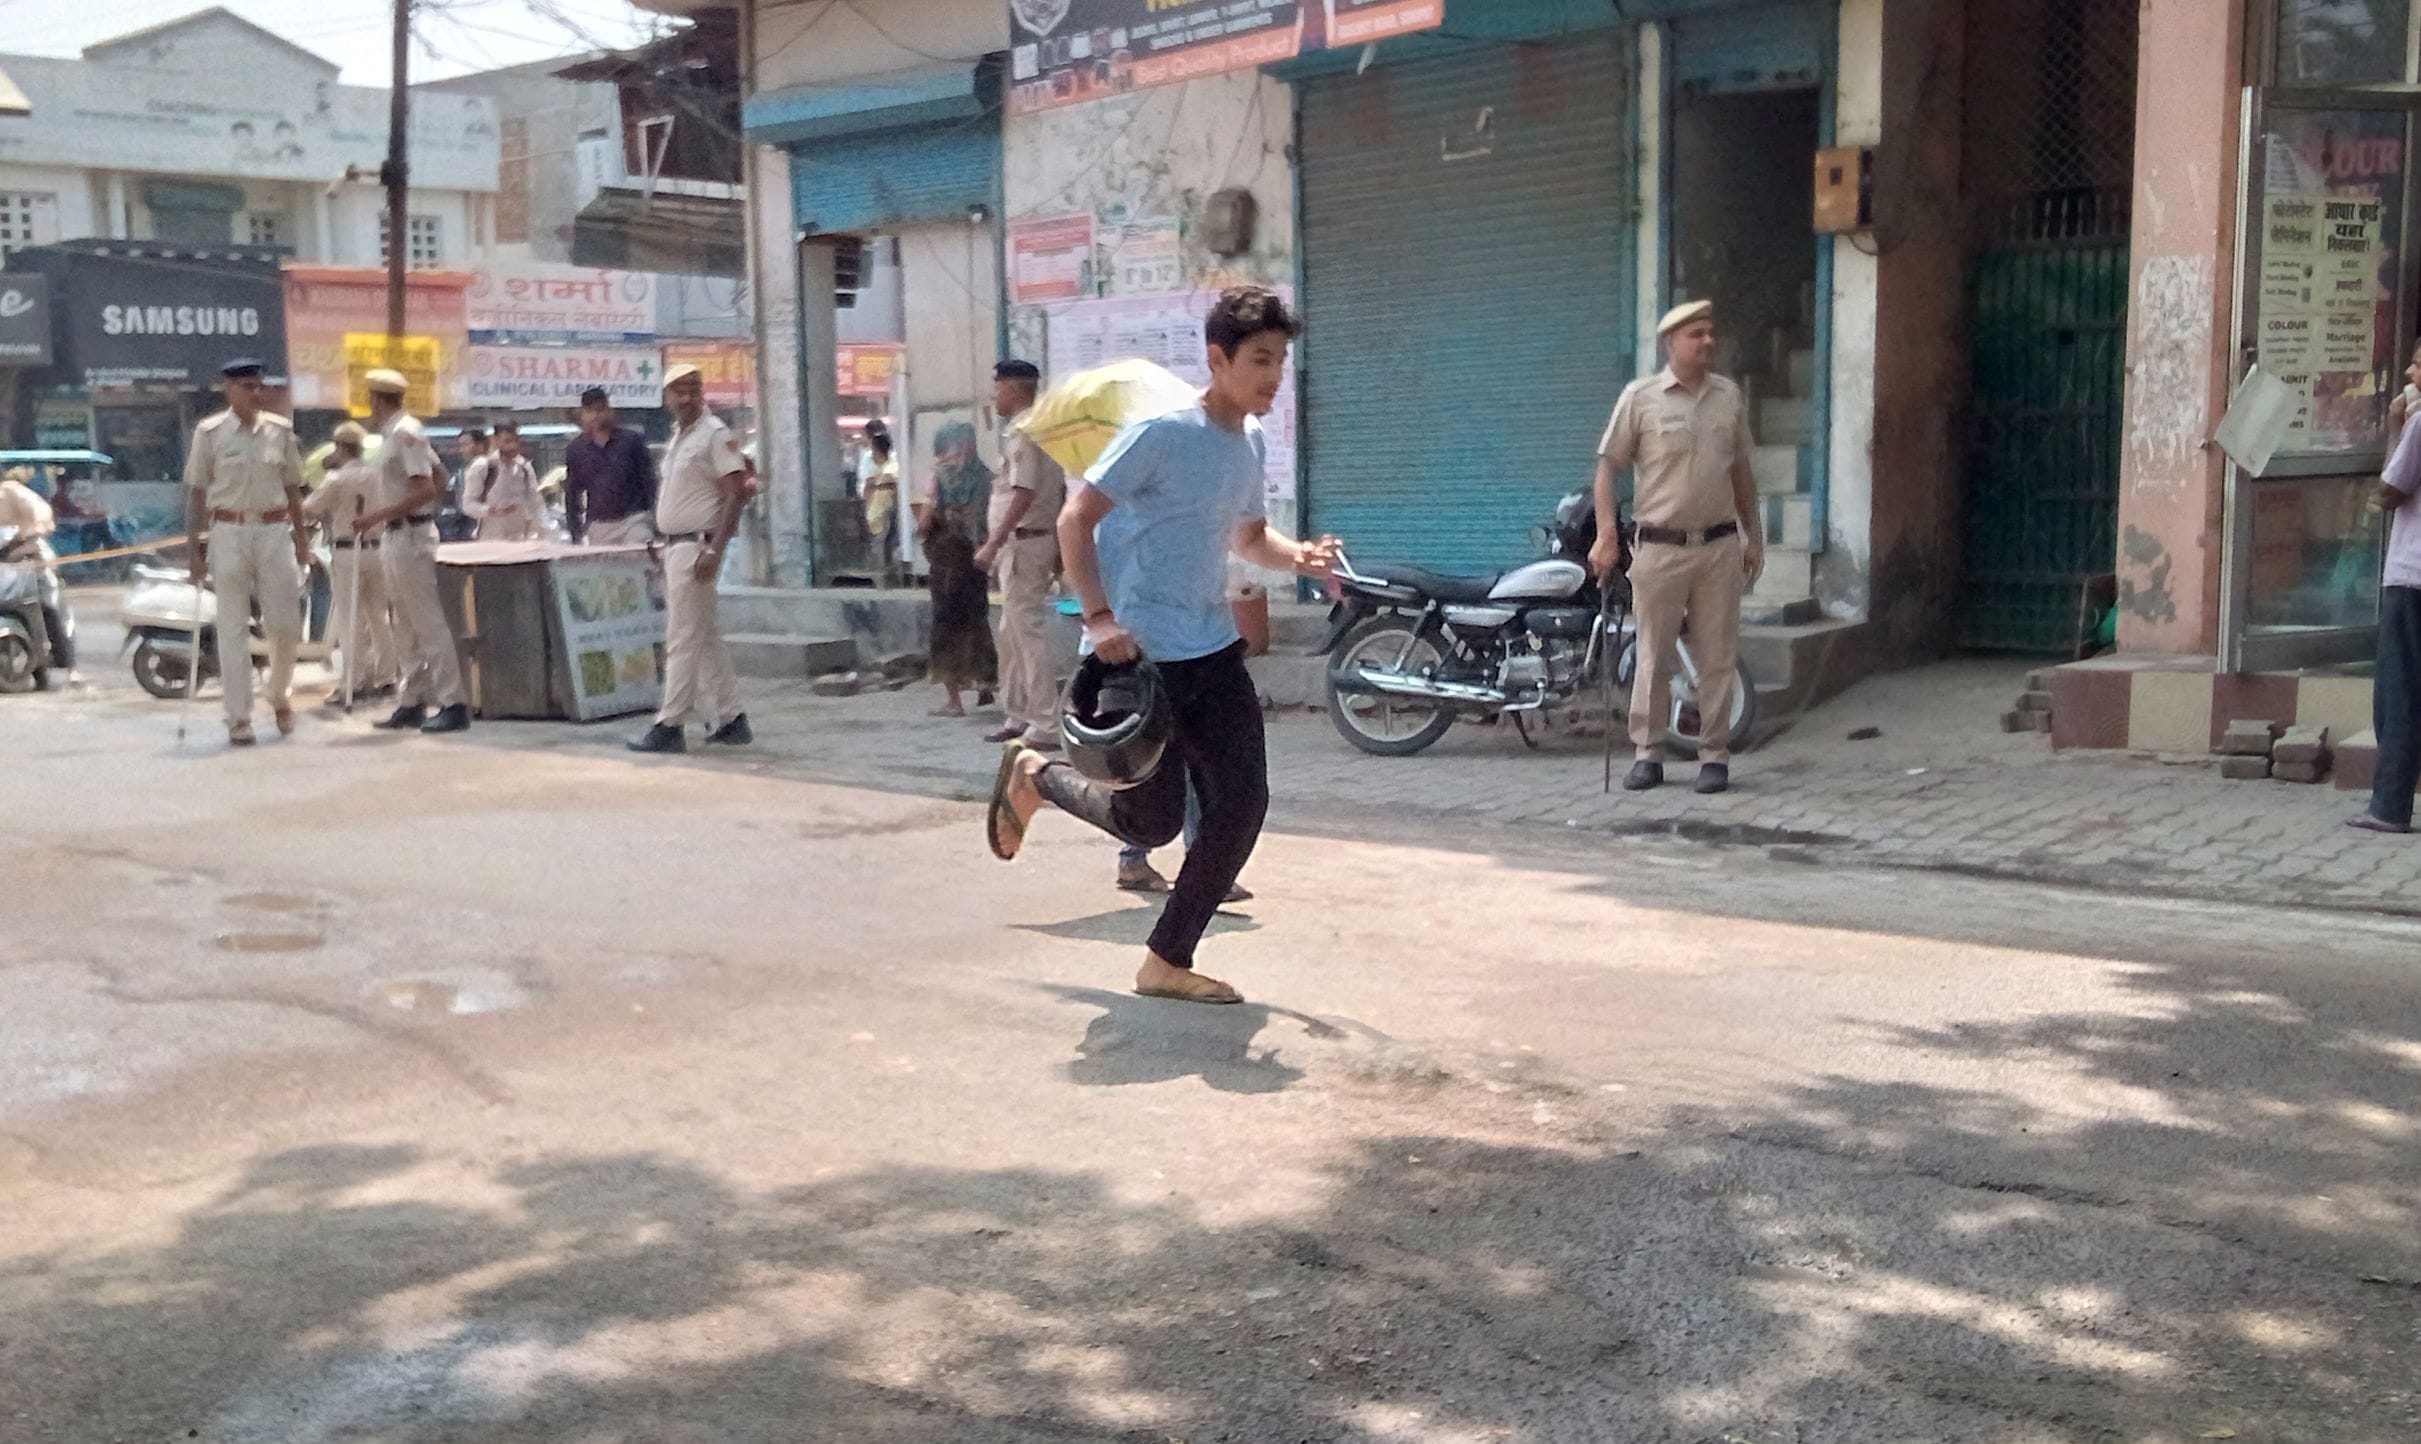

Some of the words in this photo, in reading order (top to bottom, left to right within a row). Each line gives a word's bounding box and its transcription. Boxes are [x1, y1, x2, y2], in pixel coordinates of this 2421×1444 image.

[505, 268, 613, 302] शर्मा
[102, 304, 260, 336] SAMSUNG
[2268, 320, 2308, 331] COLOUR
[2327, 333, 2366, 343] Marriage
[499, 356, 632, 380] SHARMA
[472, 382, 548, 397] CLINICAL
